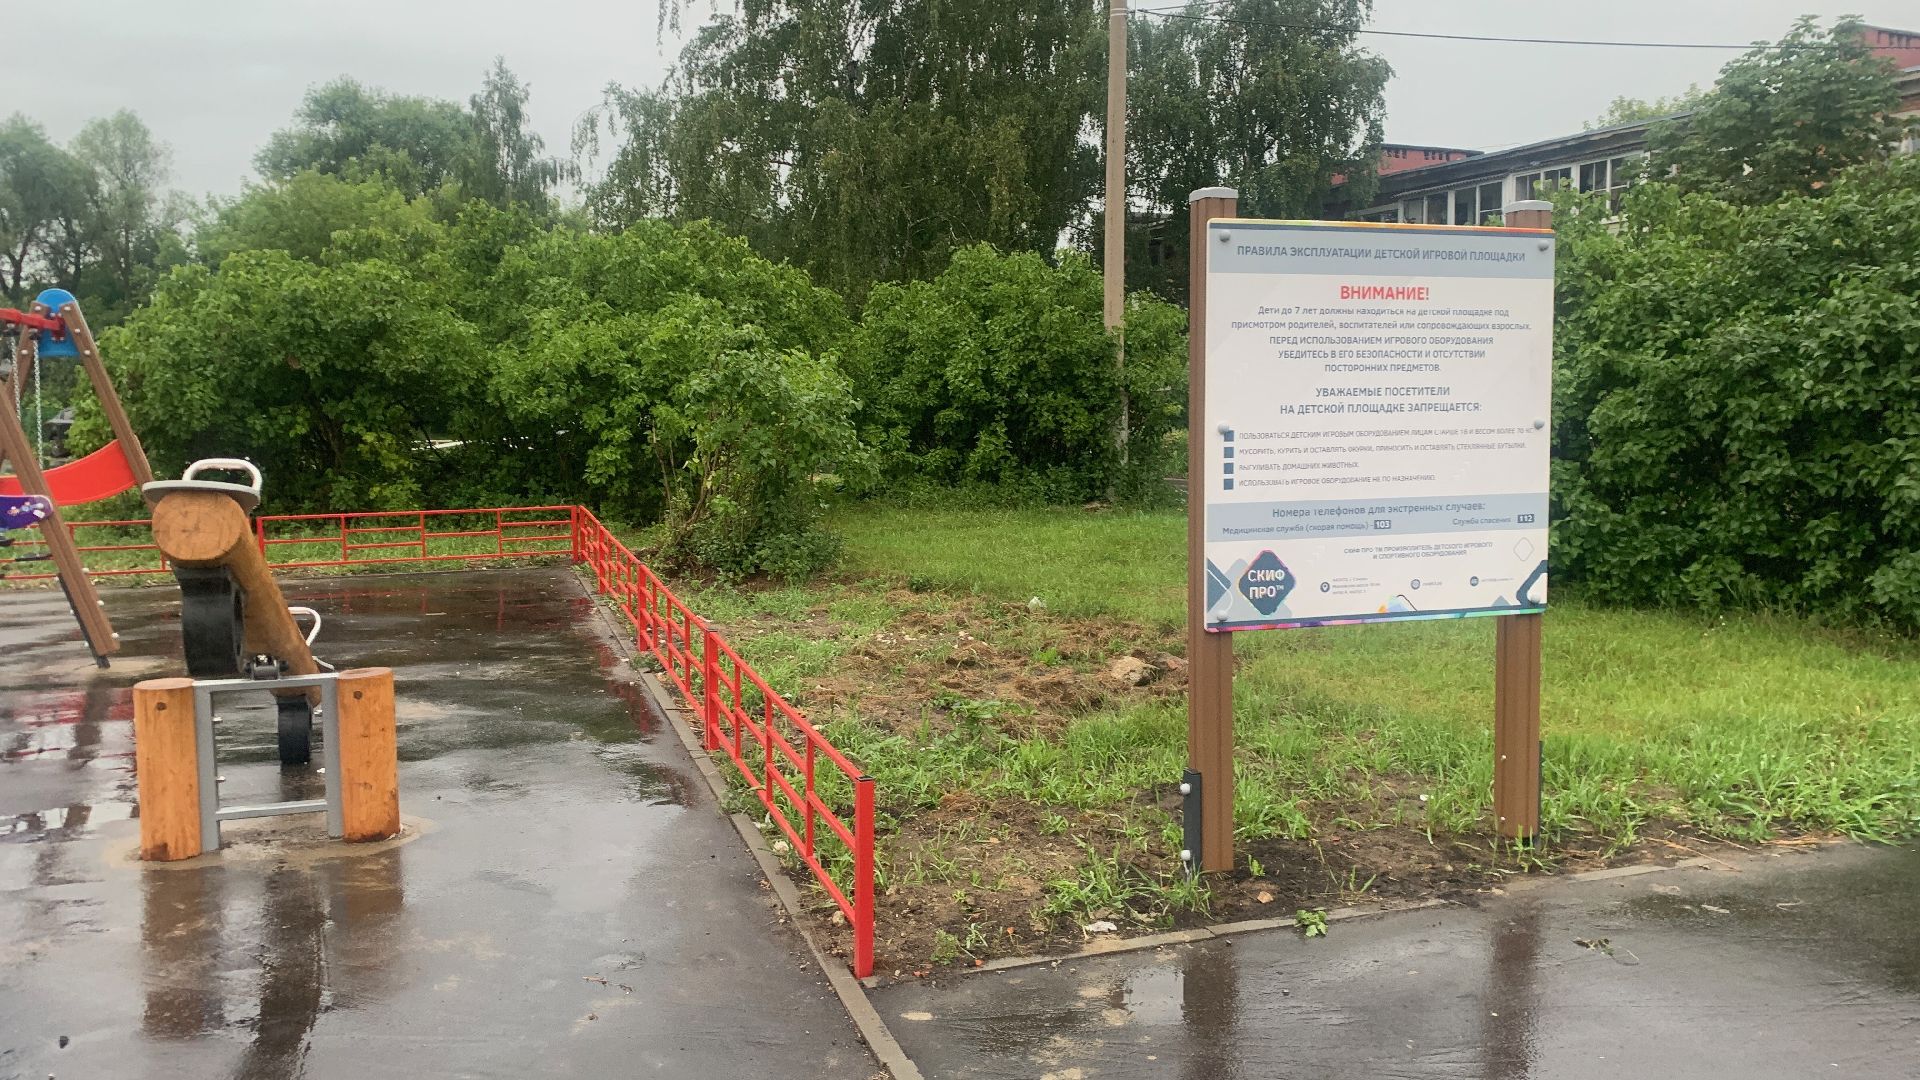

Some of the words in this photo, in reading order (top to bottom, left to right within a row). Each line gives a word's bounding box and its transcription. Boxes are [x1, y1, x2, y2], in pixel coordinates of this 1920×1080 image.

[1237, 246, 1287, 257] ПРАВИЛА
[1290, 246, 1372, 259] ЭКСПЛУАТАЦИИ
[1374, 247, 1420, 260] ДЕТСКОЙ
[1422, 248, 1468, 261] ИГРОВОЙ
[1470, 250, 1526, 263] ПЛОЩАДКИ
[1340, 285, 1430, 300] ВНИМАНИЕ!
[1258, 306, 1280, 315] Дети
[1281, 307, 1293, 316] до
[1294, 306, 1300, 315] 7
[1302, 307, 1318, 315] лет
[1319, 307, 1353, 316] должны
[1356, 307, 1405, 317] находиться
[1406, 308, 1416, 316] на
[1418, 307, 1451, 317] детской
[1452, 308, 1493, 318] площадке
[1494, 309, 1509, 318] под
[1231, 321, 1286, 330] присмотром
[1288, 319, 1337, 330] родителей,
[1339, 319, 1398, 330] воспитателей
[1399, 322, 1415, 330] или
[1416, 322, 1489, 331] сопровождающих
[1491, 322, 1532, 331] взрослых.
[1269, 336, 1298, 346] ПЕРЕД
[1300, 336, 1382, 345] ИСПОЛЬЗОВАНИЕМ
[1384, 336, 1428, 345] ИГРОВОГО
[1429, 336, 1494, 345] ОБОРУДОВАНИЯ
[1278, 349, 1329, 359] УБЕДИТЕСЬ
[1330, 349, 1337, 358] В
[1338, 349, 1354, 358] ЕГО
[1356, 349, 1423, 358] БЕЗОПАСНОСТИ
[1425, 349, 1431, 358] И
[1432, 349, 1486, 358] ОТСУТСТВИИ
[1324, 364, 1389, 373] ПОСТОРОННИХ
[1315, 387, 1382, 398] УВАЖАЕМЫЕ
[1385, 386, 1451, 397] ПОСЕТИТЕЛИ
[1280, 404, 1295, 415] НА
[1297, 402, 1345, 415] ДЕТСКОЙ
[1347, 403, 1405, 414] ПЛОЩАДКЕ
[1407, 402, 1483, 413] ЗАПРЕЩАЕТСЯ:
[1239, 432, 1290, 440] ПОЛЬЗОВАТЬСЯ
[1290, 431, 1321, 439] ДЕТСКИМ
[1322, 430, 1355, 438] ИГРОВЫМ
[1355, 429, 1410, 438] ОБОРУДОВАНИЕМ
[1475, 427, 1496, 435] ВЕСОМ
[1497, 427, 1516, 435] БОЛЕЕ
[1239, 448, 1276, 456] МУСОРИТЬ,
[1277, 447, 1302, 455] КУРИТЬ
[1376, 444, 1413, 452] ПРИНОСИТЬ
[1420, 443, 1456, 451] ОСТАВЛЯТЬ
[1457, 442, 1496, 450] СТЕКЛЯННЫЕ
[1239, 463, 1281, 471] ВЫГУЛИВАТЬ
[1282, 462, 1321, 471] ДОМАШНИХ
[1239, 479, 1290, 487] ИСПОЛЬЗОВАТЬ
[1291, 478, 1320, 486] ИГРОВОЕ
[1321, 477, 1371, 485] ОБОРУДОВАНИЕ
[1272, 508, 1311, 518] Номера
[1313, 506, 1366, 518] телефонов
[1368, 506, 1386, 516] для
[1388, 504, 1443, 516] экстренных
[1445, 502, 1486, 513] случаев:
[1452, 517, 1479, 526] Служба
[1480, 516, 1512, 525] спасения
[1519, 515, 1533, 523] 112
[1222, 526, 1275, 535] Медицинская
[1276, 524, 1304, 534] служба
[1305, 523, 1335, 533] (скорая
[1336, 522, 1369, 531] помощь)
[1375, 520, 1391, 529] 103
[1248, 568, 1285, 582] СКИФ
